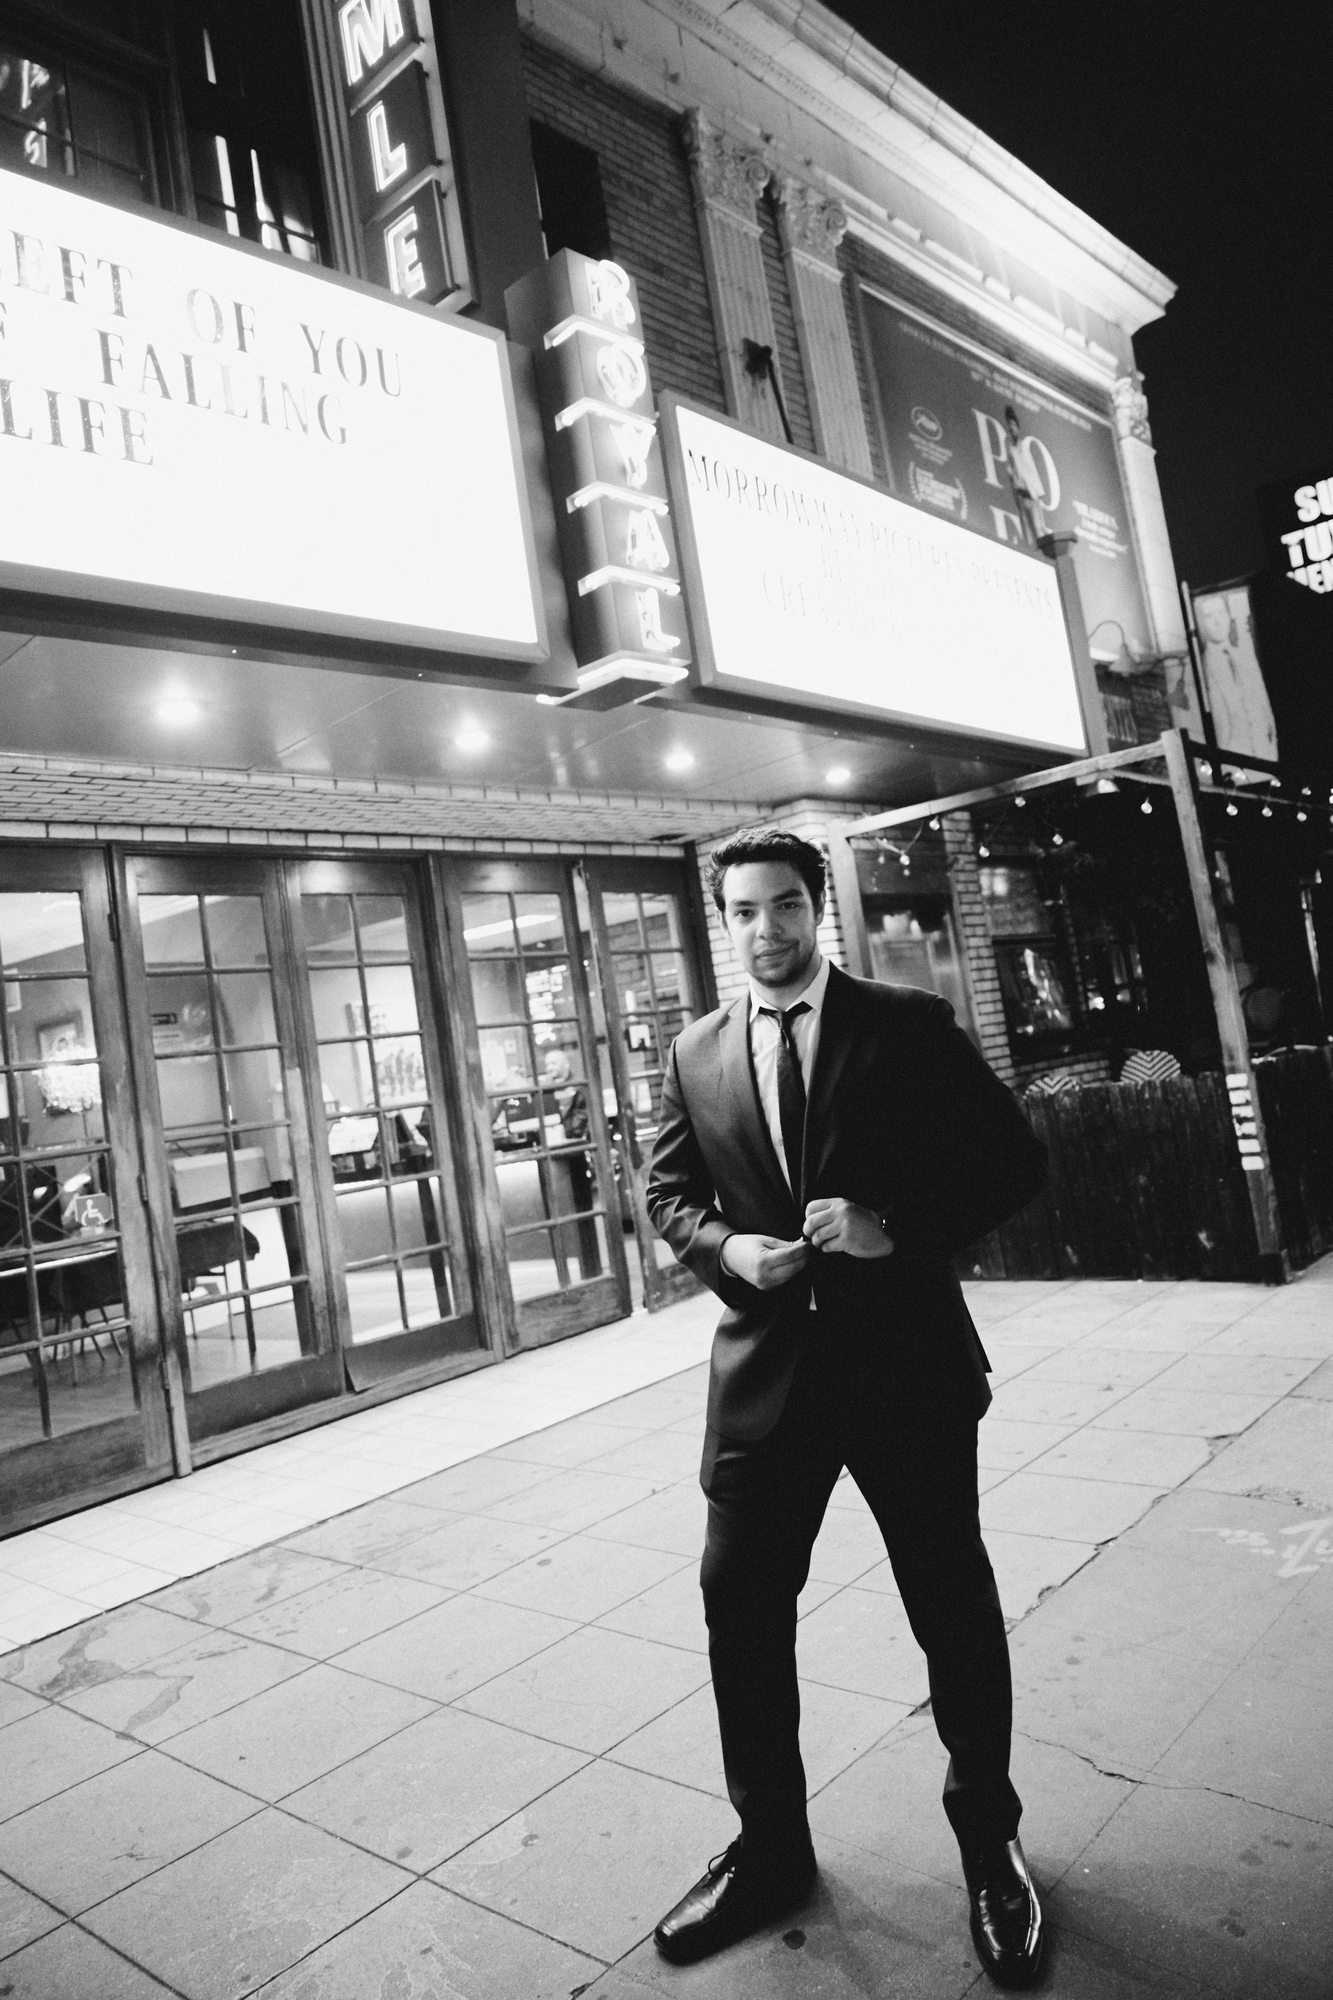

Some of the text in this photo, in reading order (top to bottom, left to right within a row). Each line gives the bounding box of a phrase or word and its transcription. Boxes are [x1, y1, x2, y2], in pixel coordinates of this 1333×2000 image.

[0, 228, 403, 398] EFT OF YOU
[0, 377, 154, 466] LIFE
[94, 328, 348, 445] FALLING
[584, 259, 682, 652] ROYAL
[1280, 518, 1333, 569] TU
